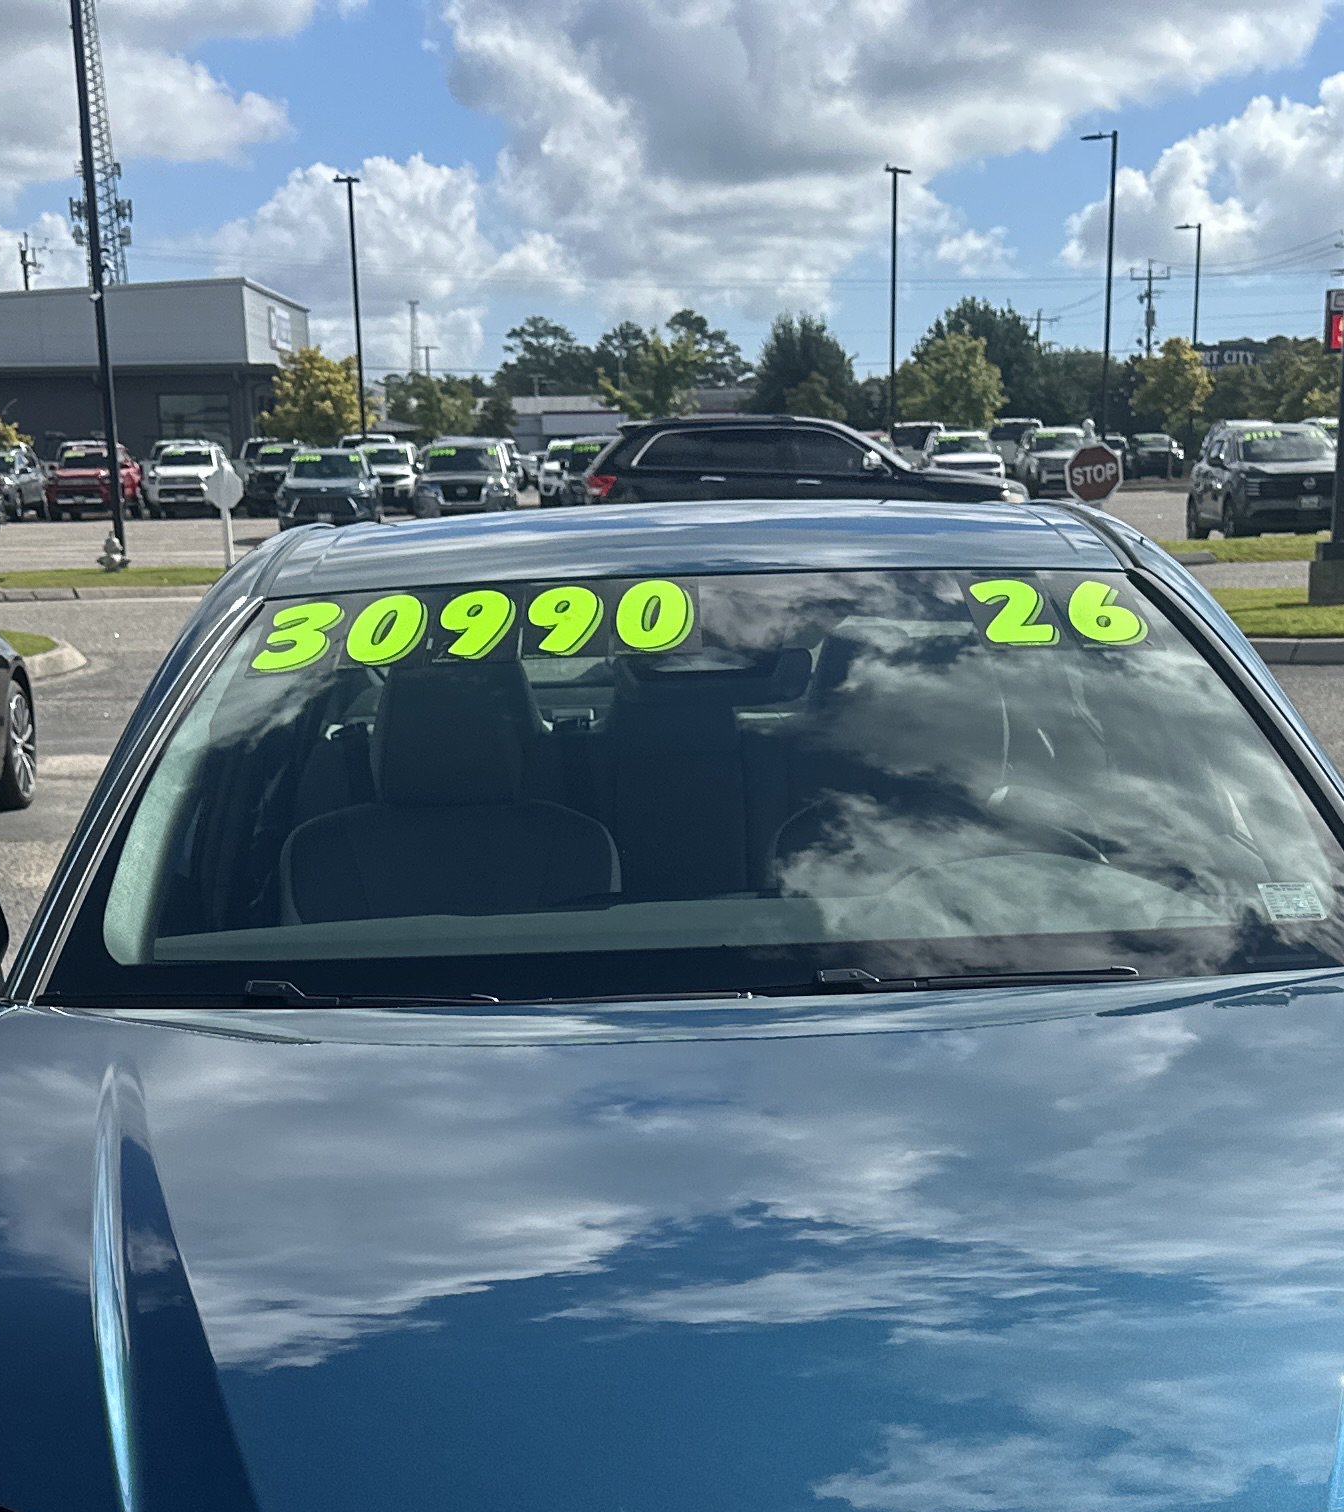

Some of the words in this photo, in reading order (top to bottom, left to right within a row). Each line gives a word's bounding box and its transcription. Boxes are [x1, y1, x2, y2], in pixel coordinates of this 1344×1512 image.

[1223, 350, 1255, 365] CITY
[1071, 463, 1117, 486] STOP
[250, 579, 695, 673] 30990
[968, 579, 1149, 647] 26
